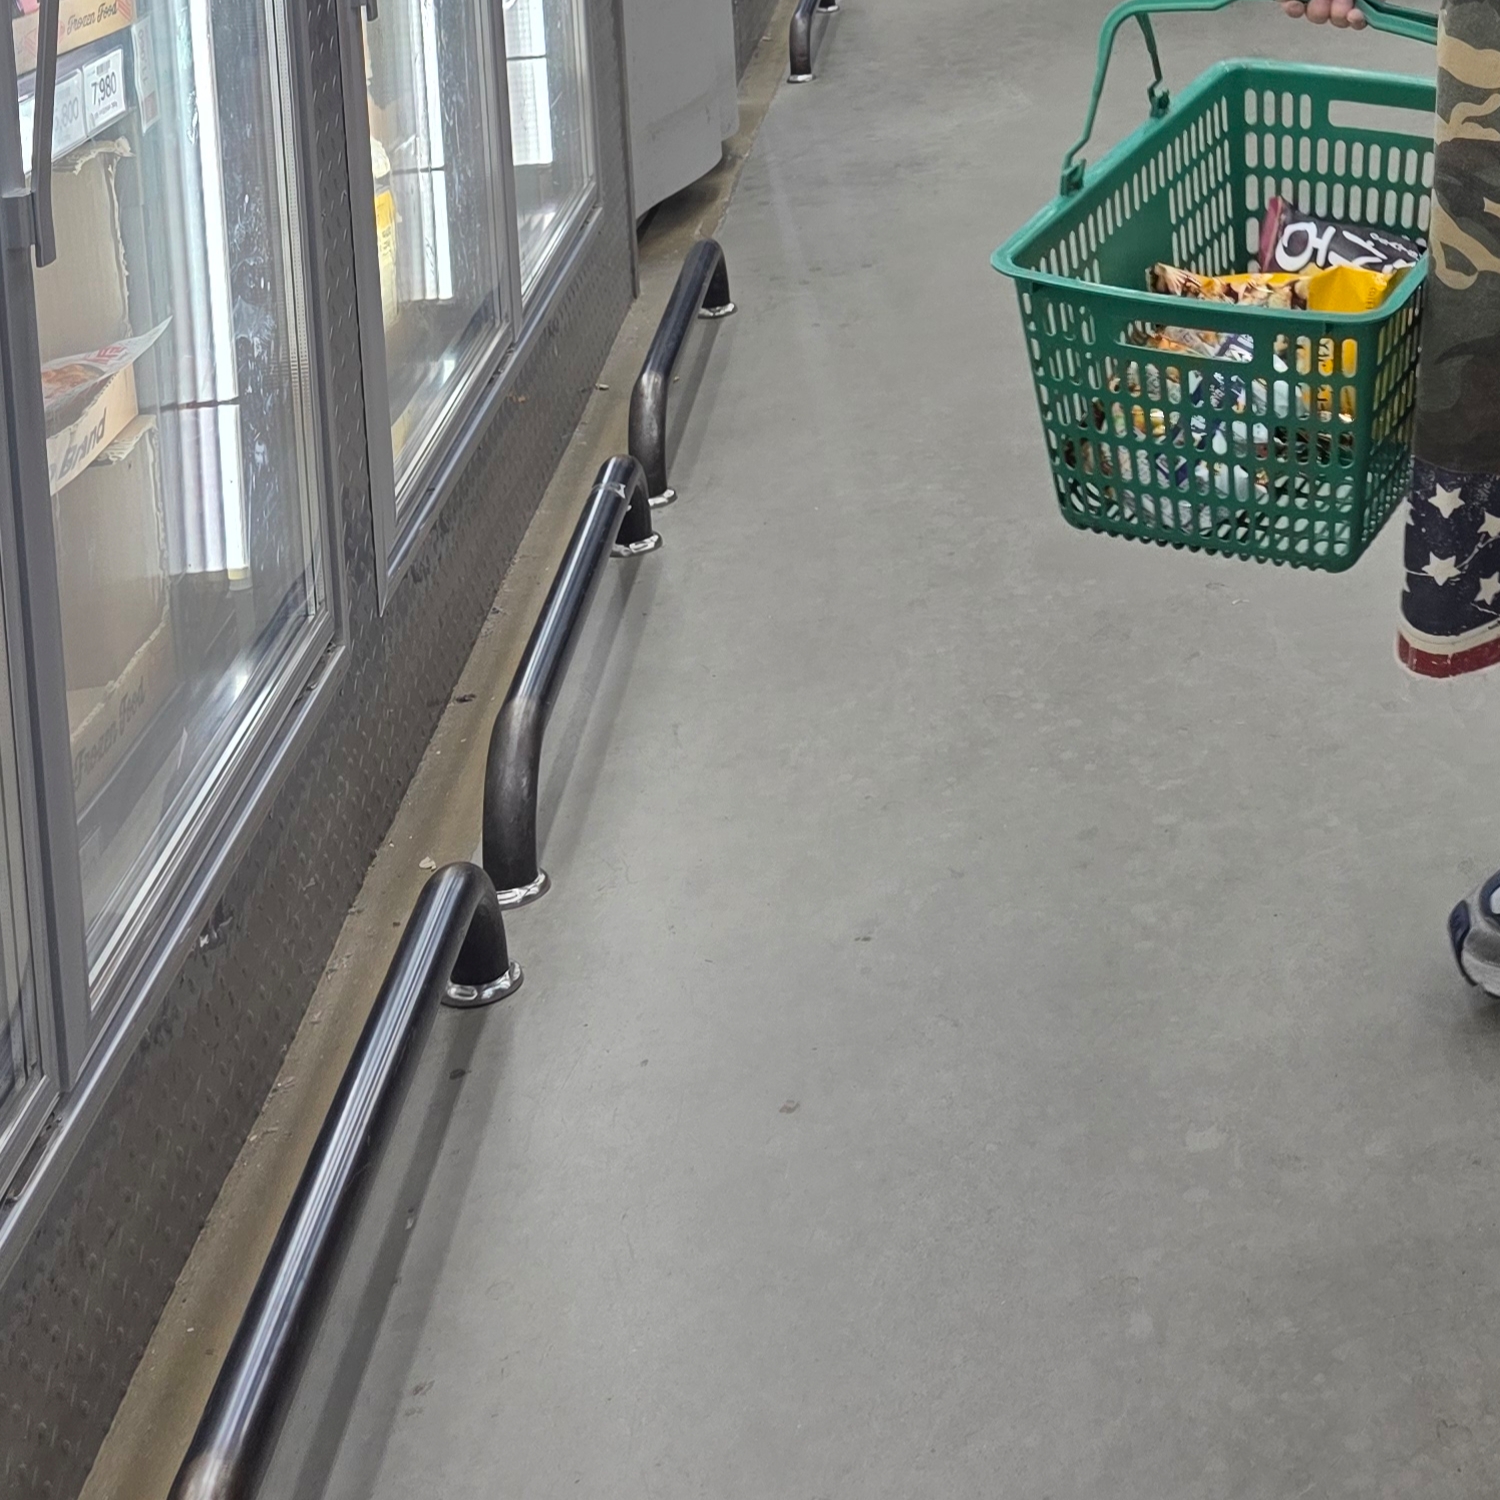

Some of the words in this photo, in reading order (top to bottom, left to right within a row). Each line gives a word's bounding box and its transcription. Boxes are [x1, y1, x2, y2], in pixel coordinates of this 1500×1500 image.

[67, 13, 95, 36] Frozen
[97, 0, 119, 23] Food
[91, 70, 117, 107] 7,980
